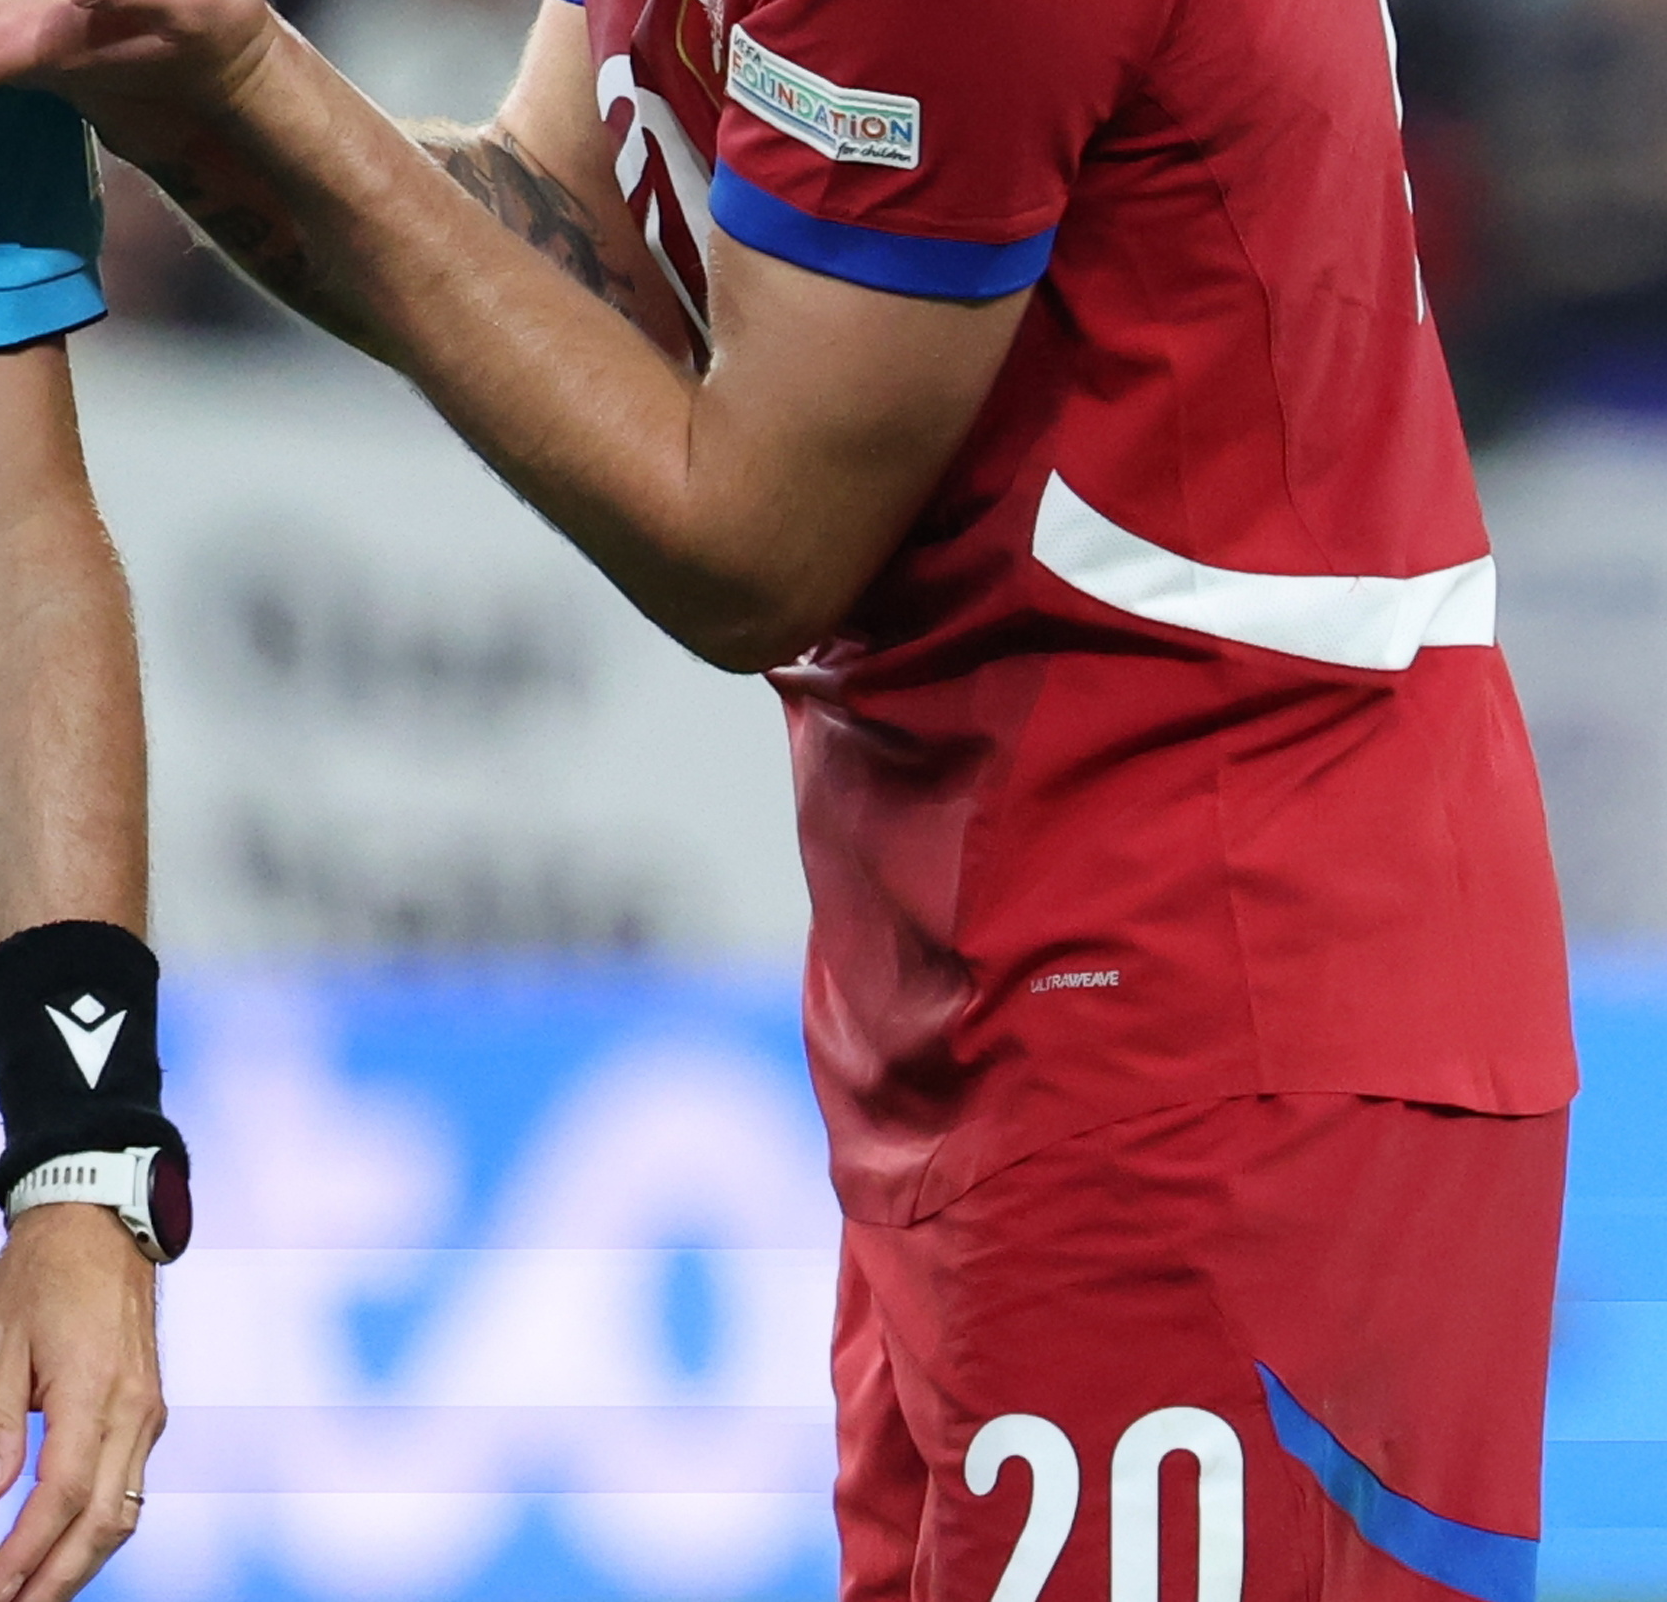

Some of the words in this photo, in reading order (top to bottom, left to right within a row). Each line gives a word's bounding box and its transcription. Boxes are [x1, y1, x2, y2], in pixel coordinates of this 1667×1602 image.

[836, 142, 859, 159] for
[860, 145, 912, 162] children
[1030, 969, 1120, 994] ULTRAWEAVE
[963, 1405, 1247, 1602] 20
